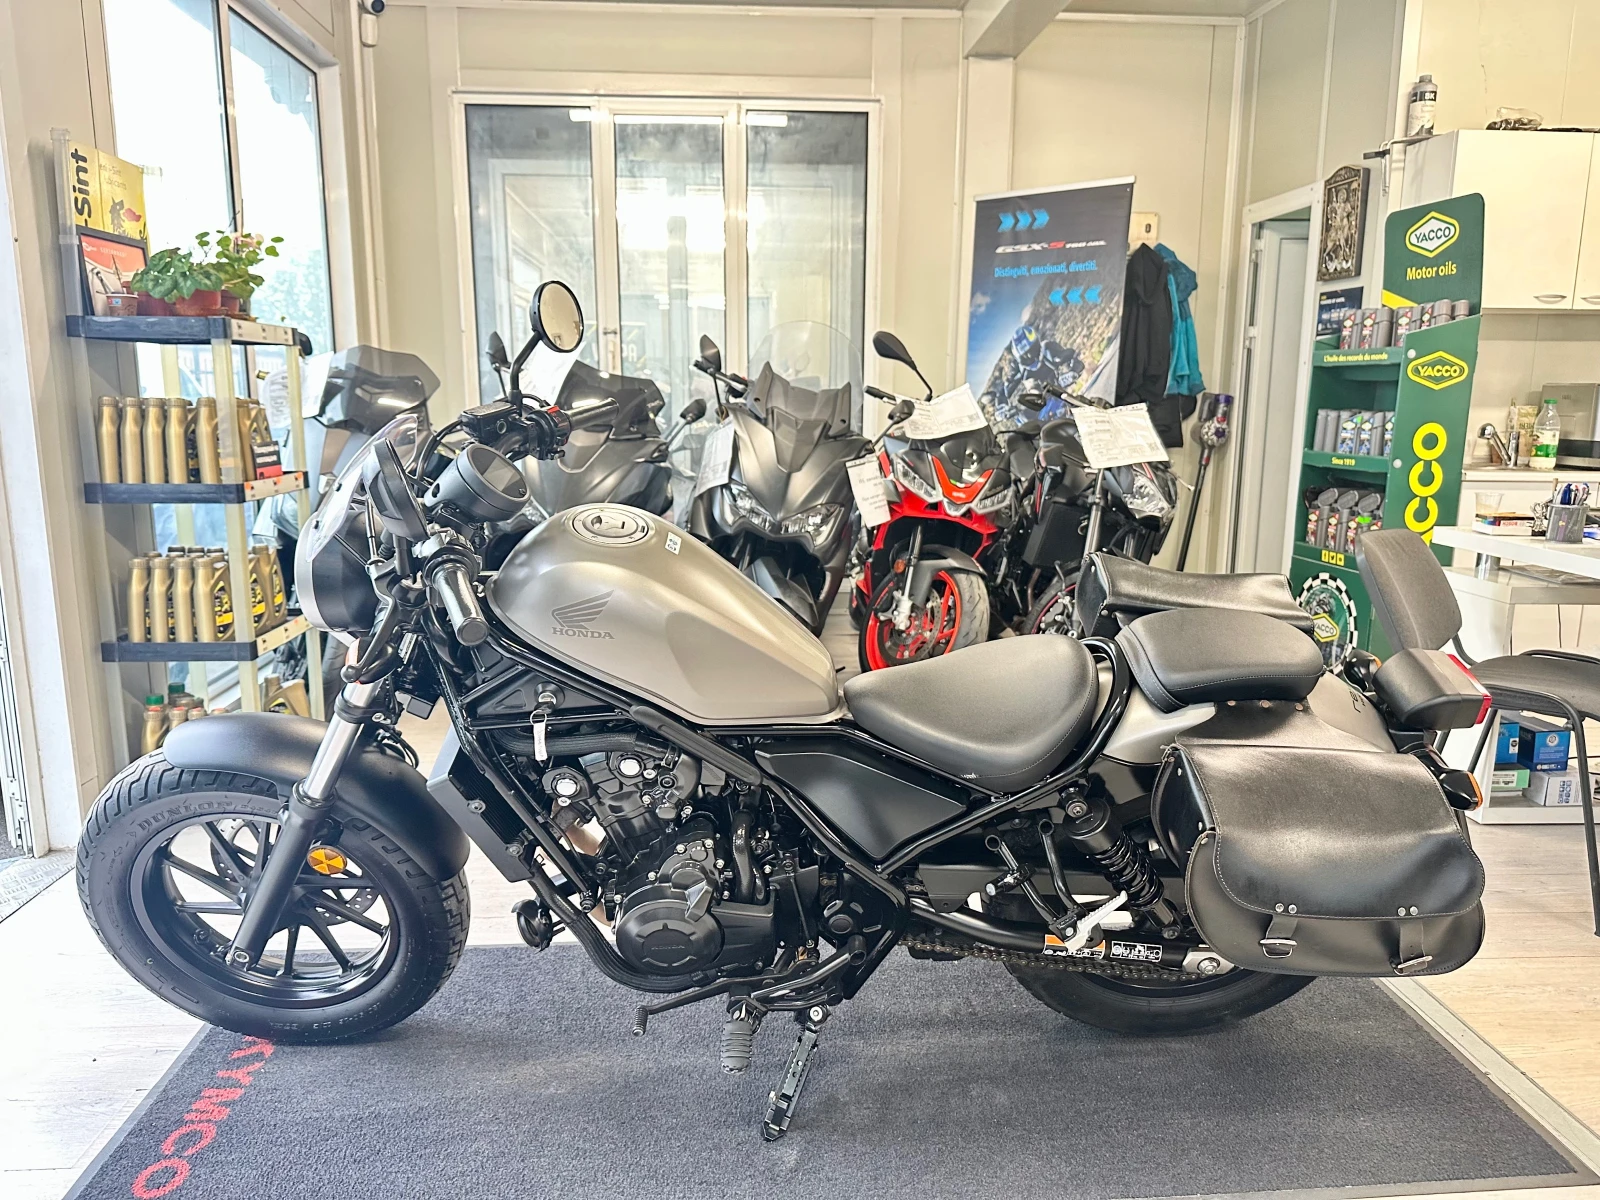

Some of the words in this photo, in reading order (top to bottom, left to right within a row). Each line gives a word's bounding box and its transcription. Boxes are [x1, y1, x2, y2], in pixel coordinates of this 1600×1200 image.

[1414, 226, 1452, 244] YACCO
[994, 264, 1029, 279] Distinguiti,
[1030, 261, 1068, 275] emozionati,
[1068, 259, 1098, 273] divertiti.
[1406, 266, 1437, 281] Motor
[1438, 260, 1457, 276] oils
[1323, 354, 1338, 363] L'huile
[1339, 354, 1347, 362] des
[1347, 353, 1364, 362] records
[1364, 352, 1371, 361] du
[1371, 351, 1388, 361] monde
[1417, 364, 1461, 378] YACCO
[1331, 456, 1344, 466] Since
[1404, 422, 1447, 547] CCO
[551, 626, 615, 640] HONDA
[137, 800, 233, 832] DUNLOP
